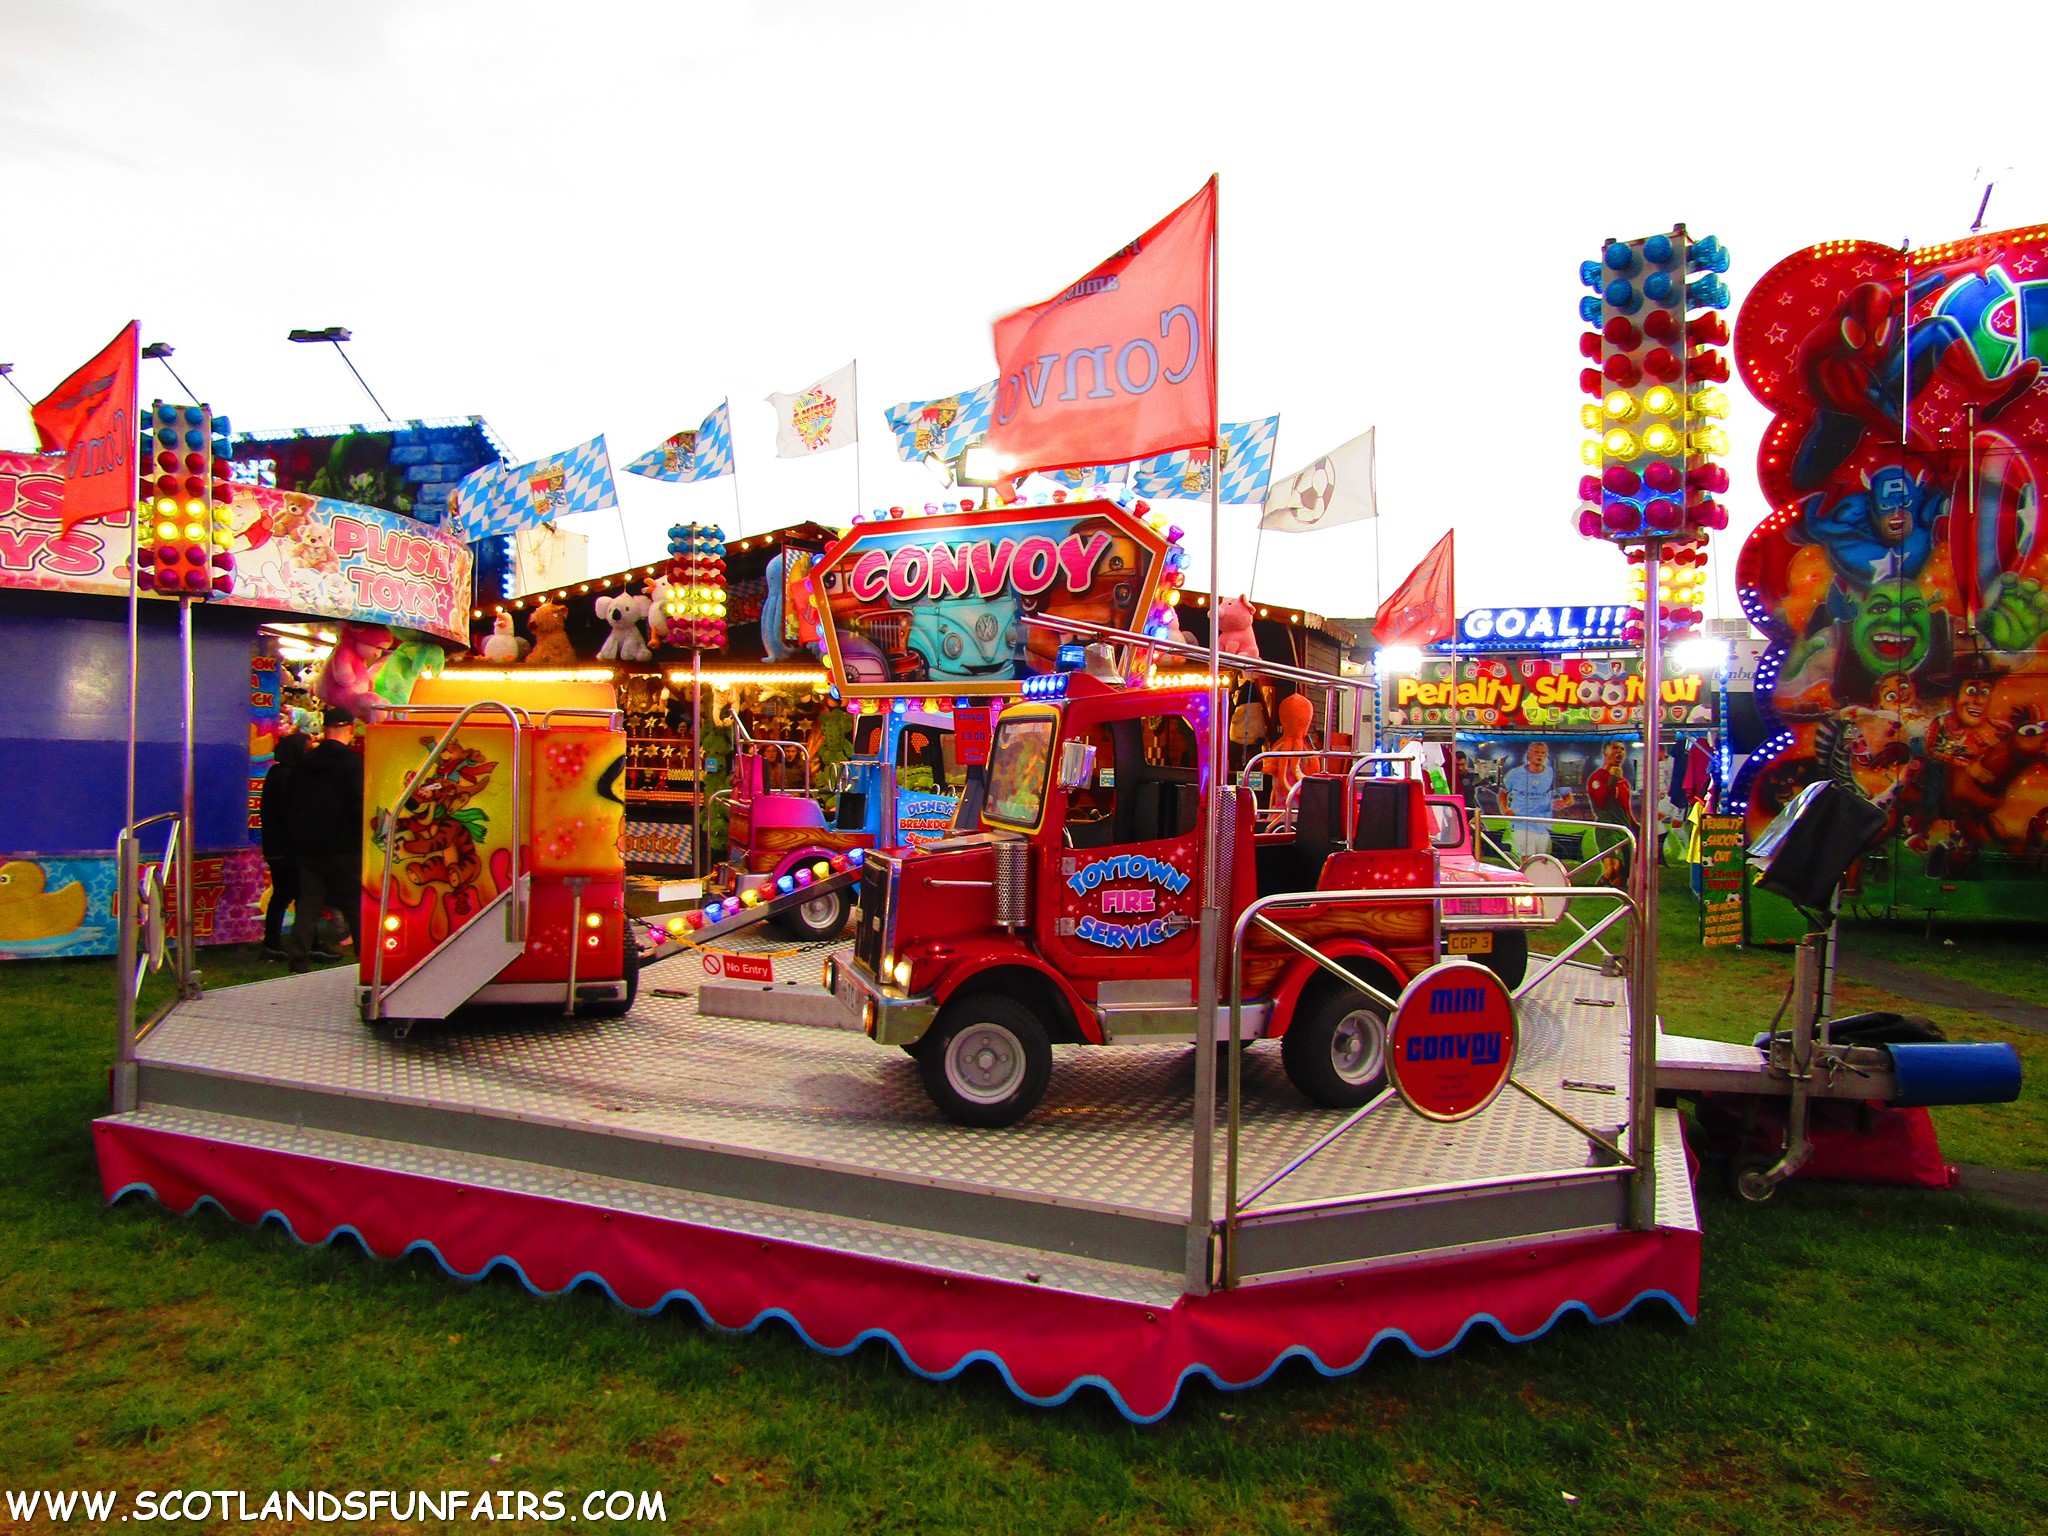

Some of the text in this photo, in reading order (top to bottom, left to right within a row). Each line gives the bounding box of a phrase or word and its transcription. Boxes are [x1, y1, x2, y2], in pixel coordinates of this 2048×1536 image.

[330, 514, 451, 584] PLUSH
[850, 530, 1112, 601] CONVOY
[347, 567, 438, 620] TOYS
[1464, 607, 1627, 639] GOAL!!!
[1398, 675, 1521, 713] Penalty
[1067, 854, 1190, 897] TOYTOWN
[1102, 889, 1155, 913] FIRE
[1452, 937, 1489, 949] CGP 3
[727, 962, 768, 977] No Entry
